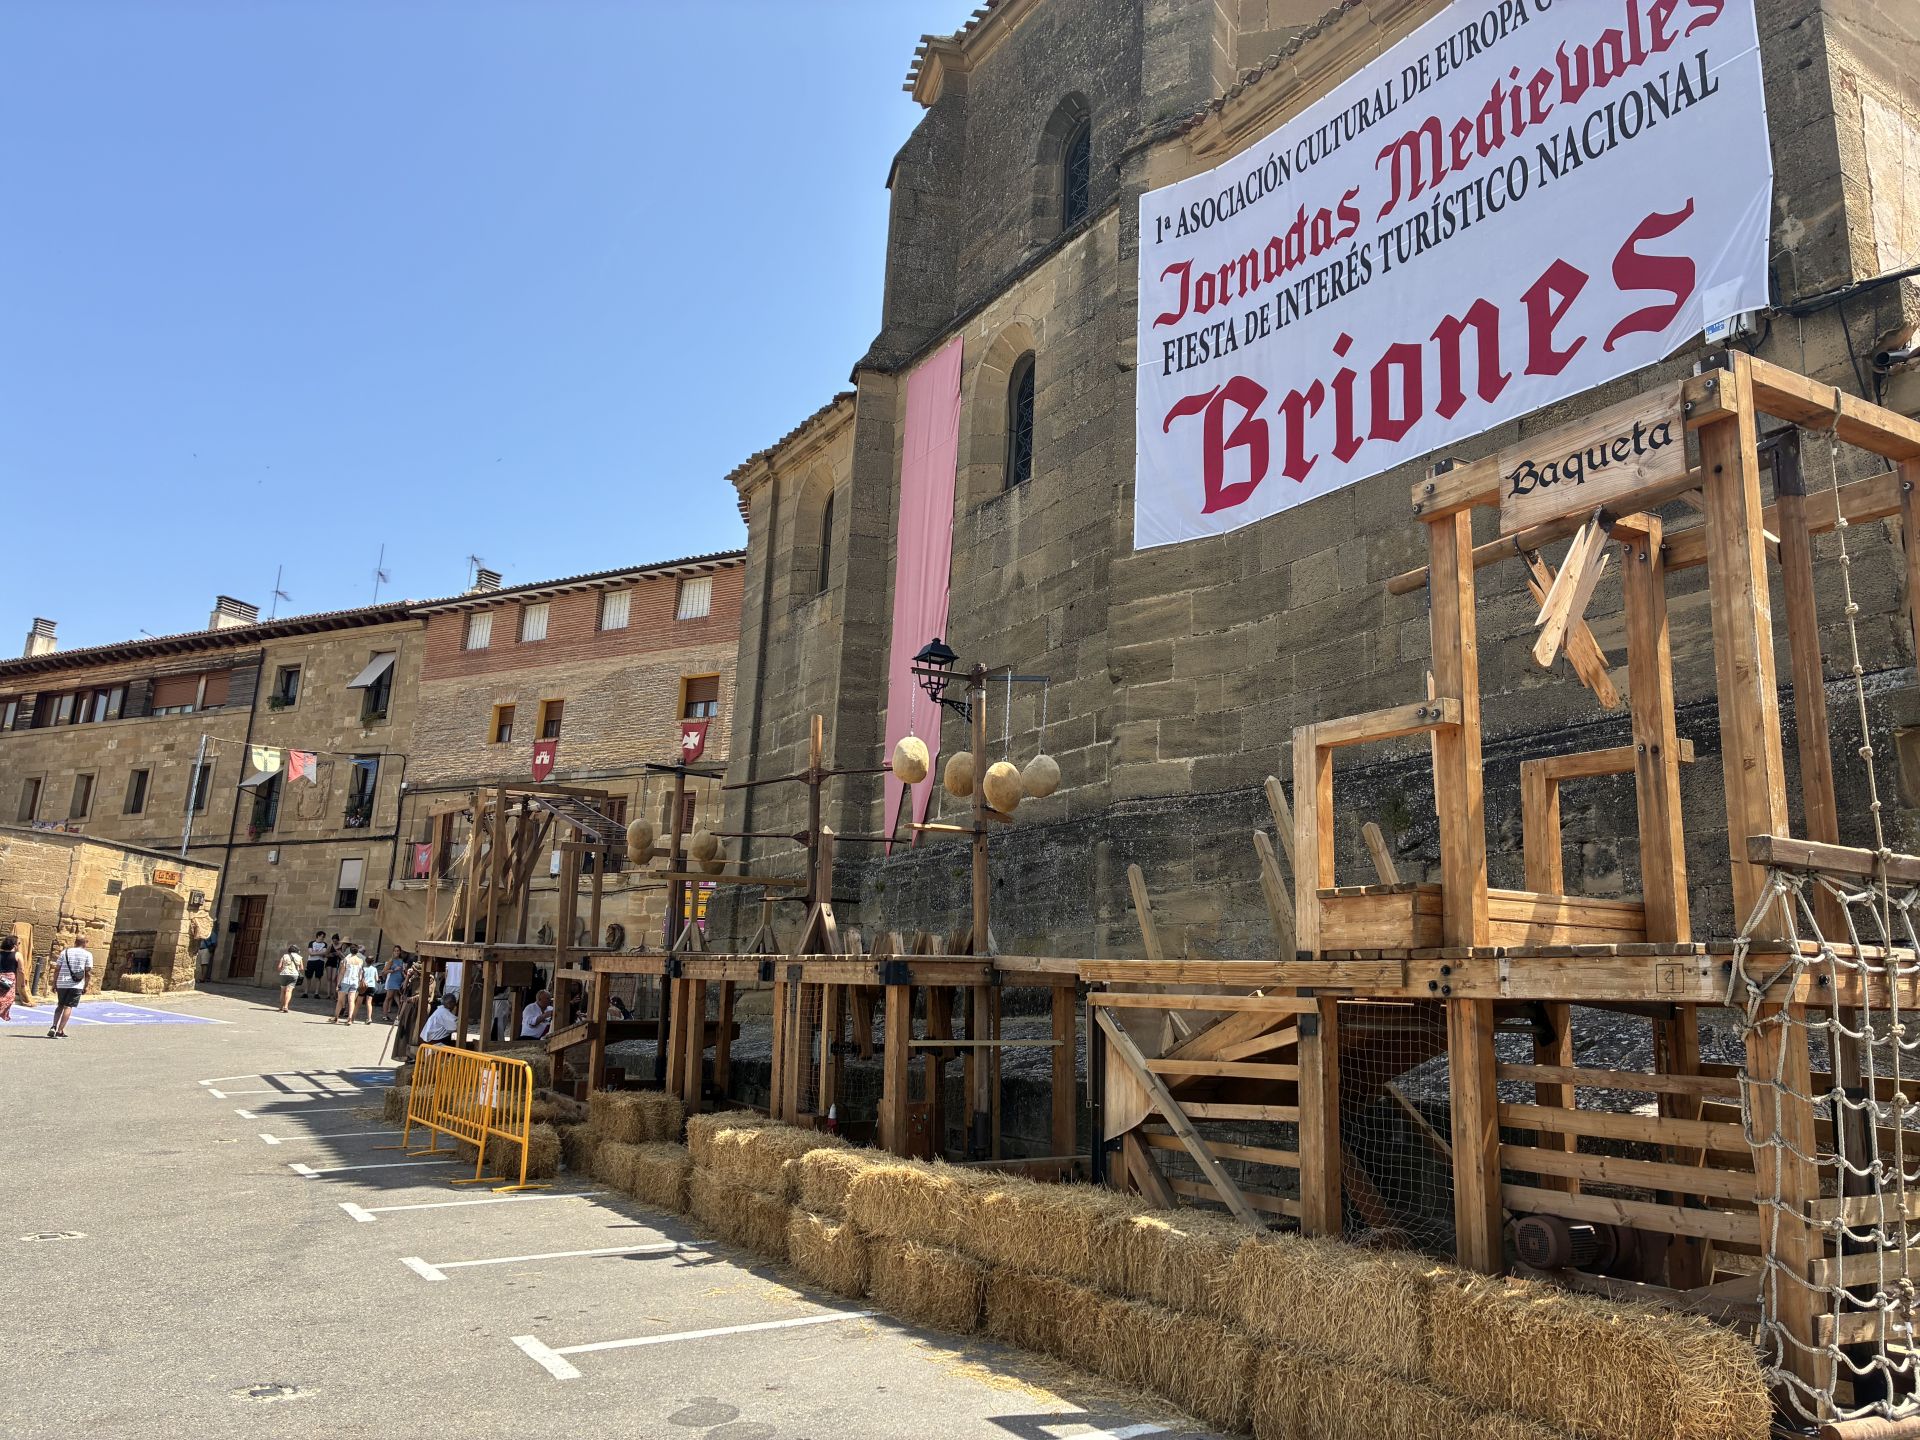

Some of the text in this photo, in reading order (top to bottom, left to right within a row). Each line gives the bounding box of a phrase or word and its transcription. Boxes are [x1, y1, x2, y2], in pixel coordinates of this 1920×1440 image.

[1155, 0, 1530, 244] 1ª ASOCIACIÓN CULTURAL DE EUROPA
[1162, 48, 1720, 376] FIESTA DE INTERÉS TURÍSTICO NACIONAL
[1152, 185, 1360, 329] Jornadas
[1162, 197, 1696, 514] Briones
[1505, 420, 1673, 498] Baqueta
